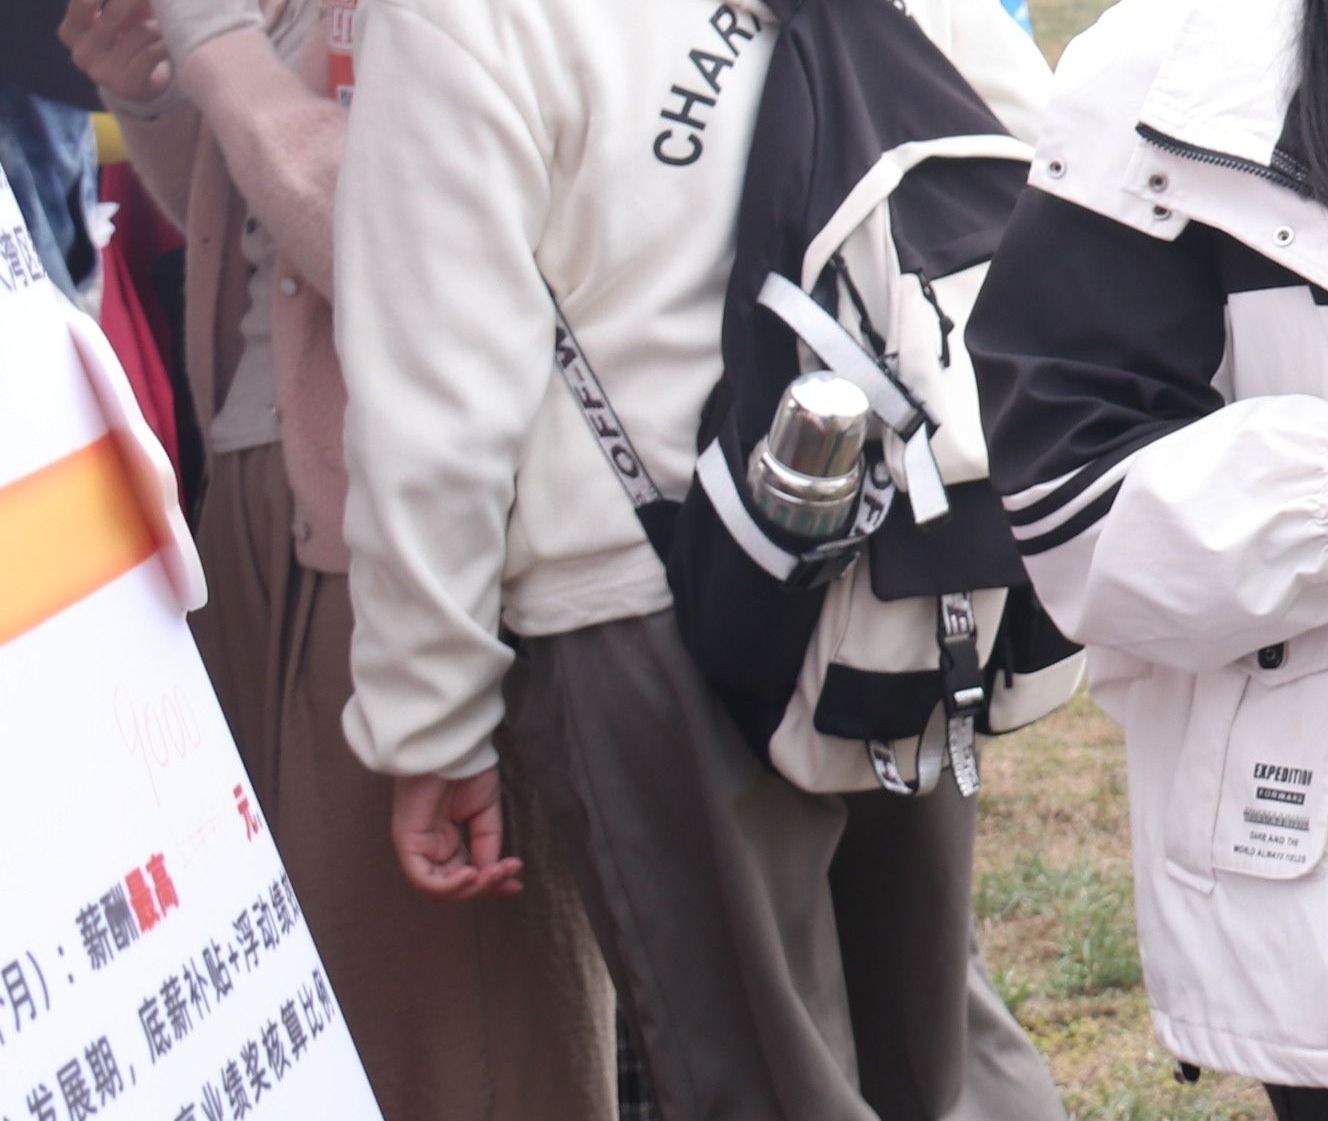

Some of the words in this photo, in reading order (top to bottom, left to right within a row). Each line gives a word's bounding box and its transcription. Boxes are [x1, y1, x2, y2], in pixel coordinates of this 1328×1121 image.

[0, 226, 44, 292] 湾区
[0, 852, 180, 1045] 月）：薪酬最高
[2, 870, 300, 1121] 发展期，底薪补贴+浮动绩
